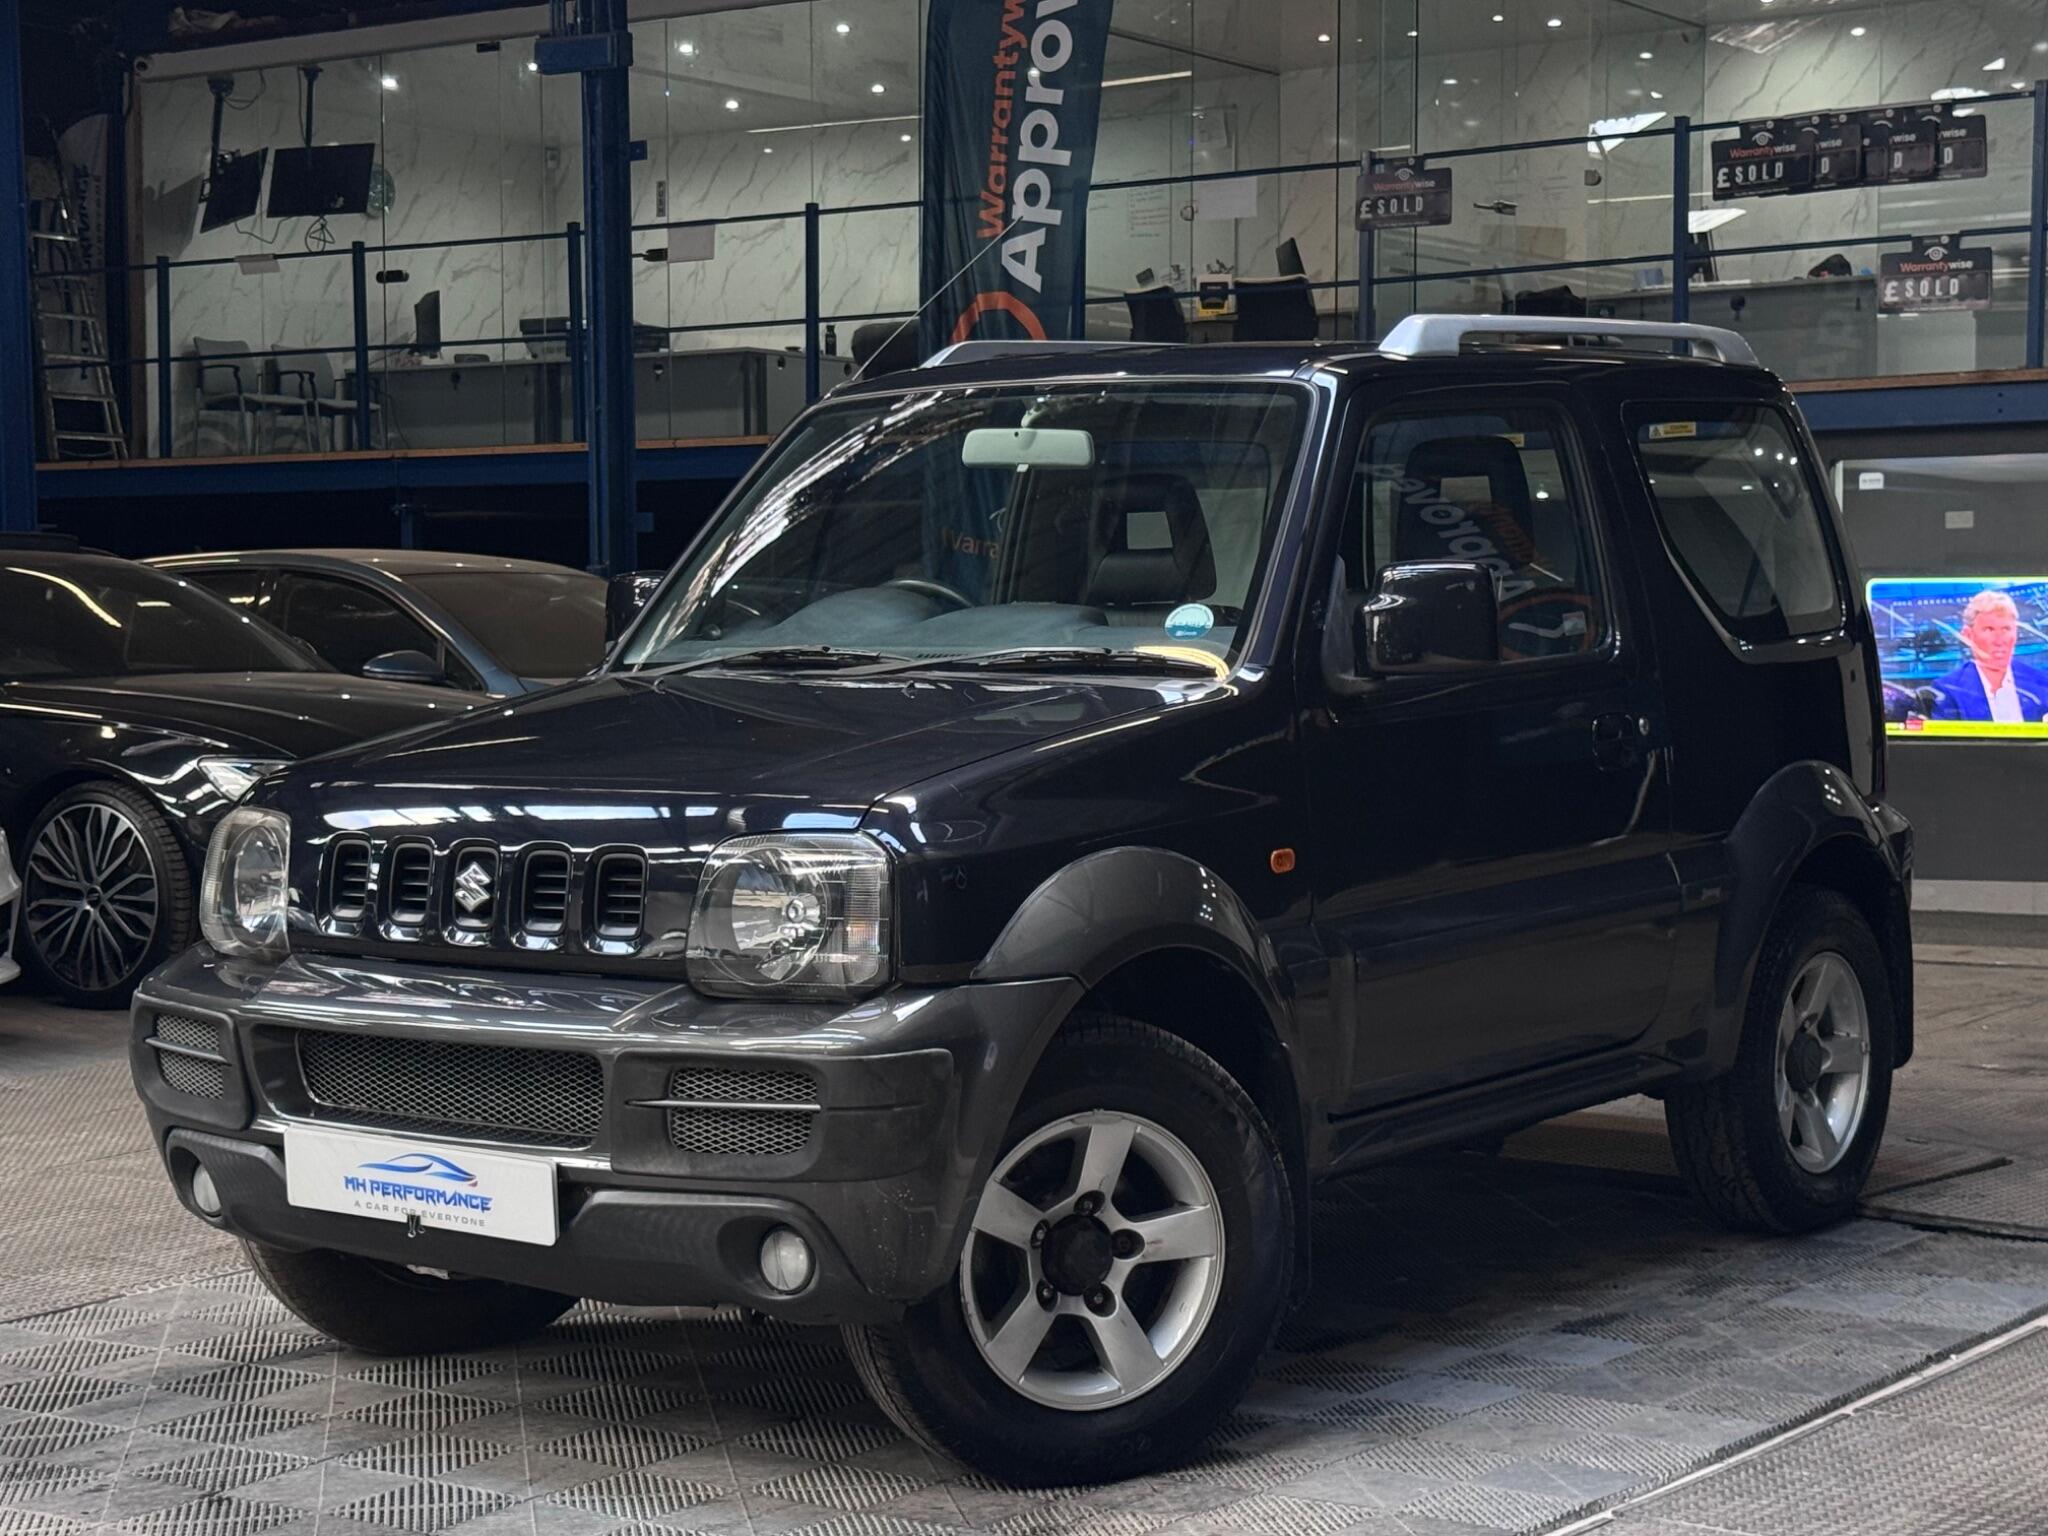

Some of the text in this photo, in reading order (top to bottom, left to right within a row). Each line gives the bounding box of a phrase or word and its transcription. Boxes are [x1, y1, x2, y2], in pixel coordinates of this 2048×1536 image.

[1729, 142, 1797, 158] Warrantywise
[1900, 259, 1974, 272] Warrantywise
[343, 1175, 493, 1213] MH PERFORMANCE
[366, 1201, 389, 1212] CAR
[394, 1205, 417, 1216] FOR
[422, 1210, 486, 1227] EVERYONE
